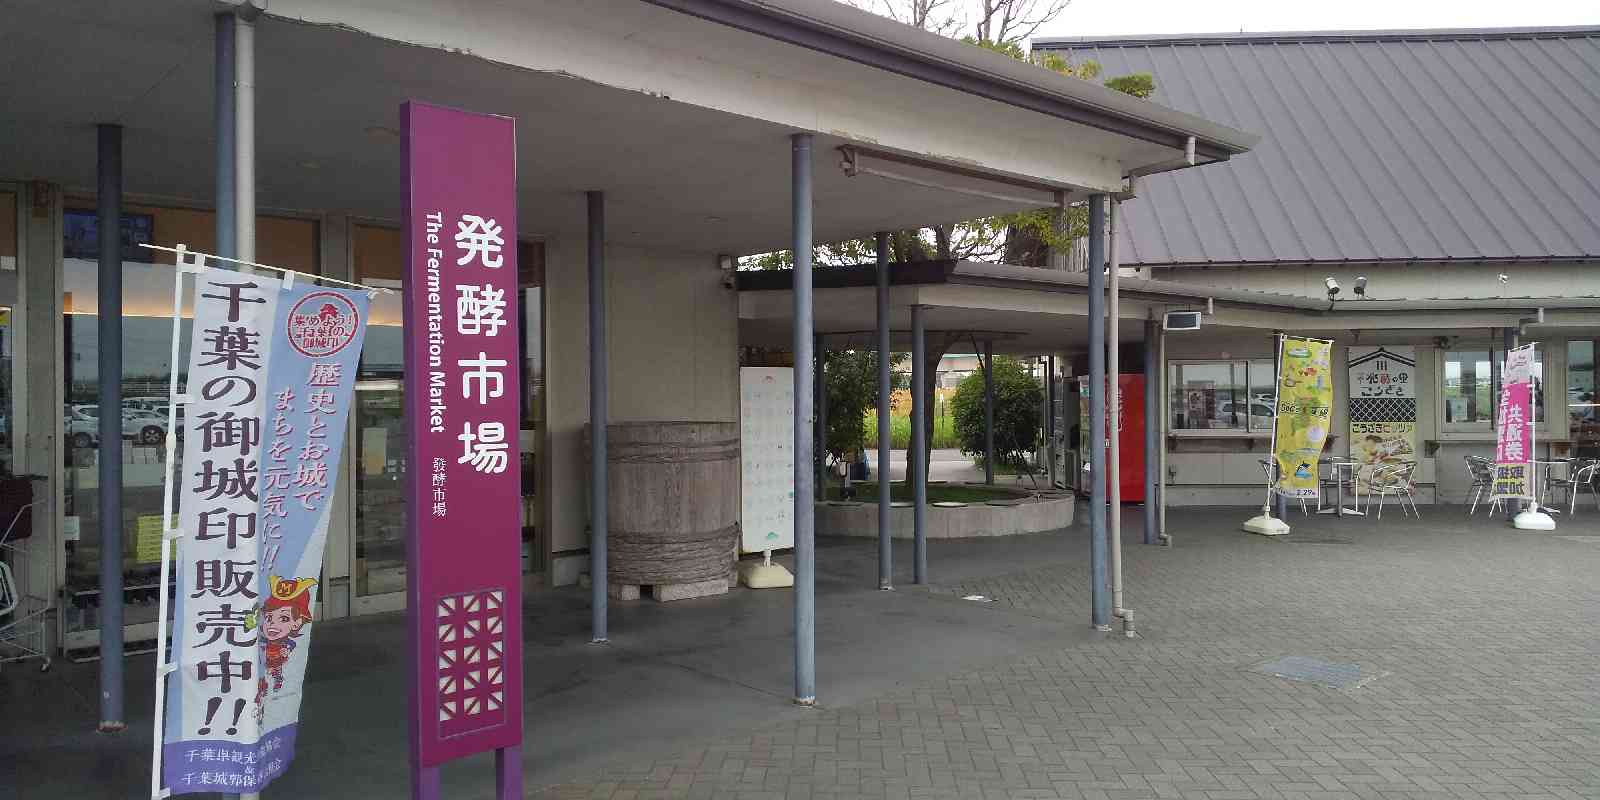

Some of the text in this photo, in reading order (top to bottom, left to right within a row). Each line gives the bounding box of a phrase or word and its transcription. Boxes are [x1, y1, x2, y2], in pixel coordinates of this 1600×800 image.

[426, 211, 445, 433] The Fermentation Market
[454, 213, 509, 474] 発酵市場
[293, 362, 343, 512] 歴史とお城で
[431, 456, 447, 518] 發酵市場
